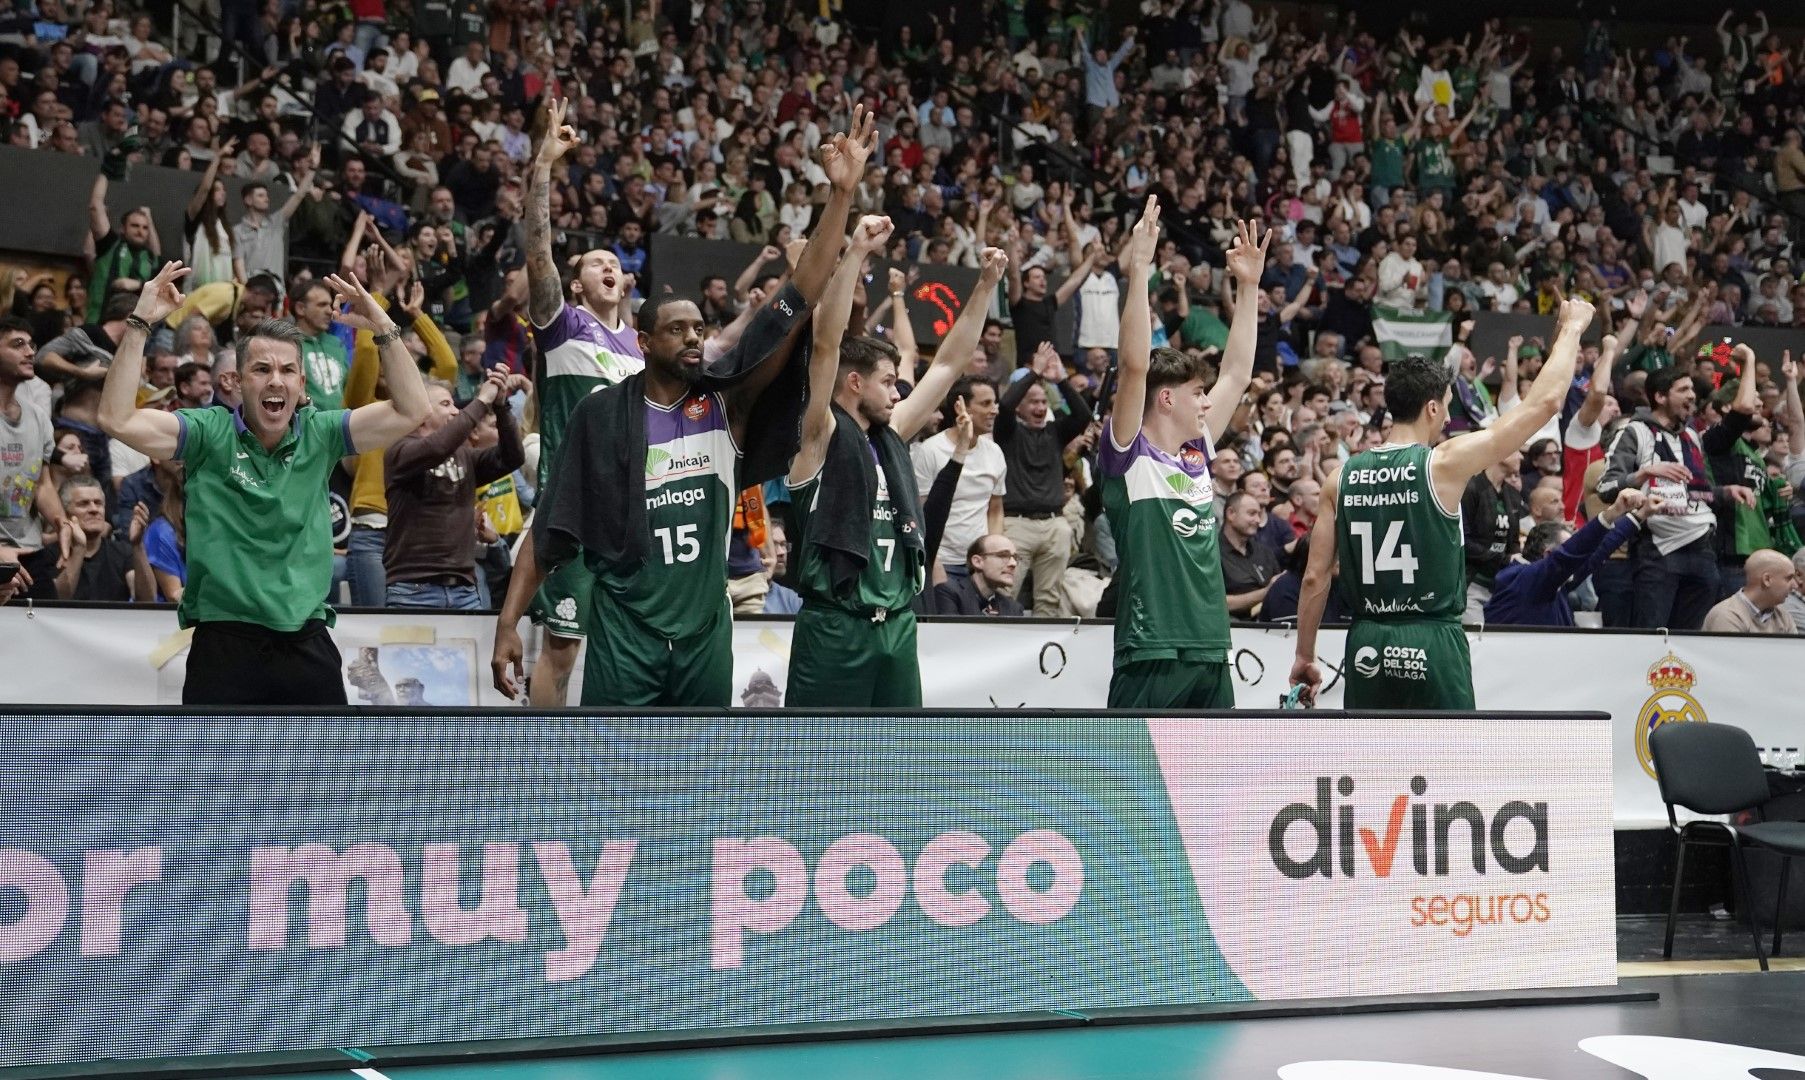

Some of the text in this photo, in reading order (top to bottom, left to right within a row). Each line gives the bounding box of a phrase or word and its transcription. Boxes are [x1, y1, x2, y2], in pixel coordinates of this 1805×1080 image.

[1343, 489, 1419, 507] BENAHAVÍS
[654, 523, 701, 565] 15
[877, 538, 896, 572] 7
[1350, 520, 1419, 585] 14
[1364, 597, 1425, 614] Andalucía
[1383, 645, 1427, 661] COSTA
[1383, 658, 1428, 672] DEL SOL
[1268, 775, 1550, 880] divina
[248, 841, 639, 983] muy
[711, 829, 1085, 970] poco
[1410, 892, 1552, 937] seguros
